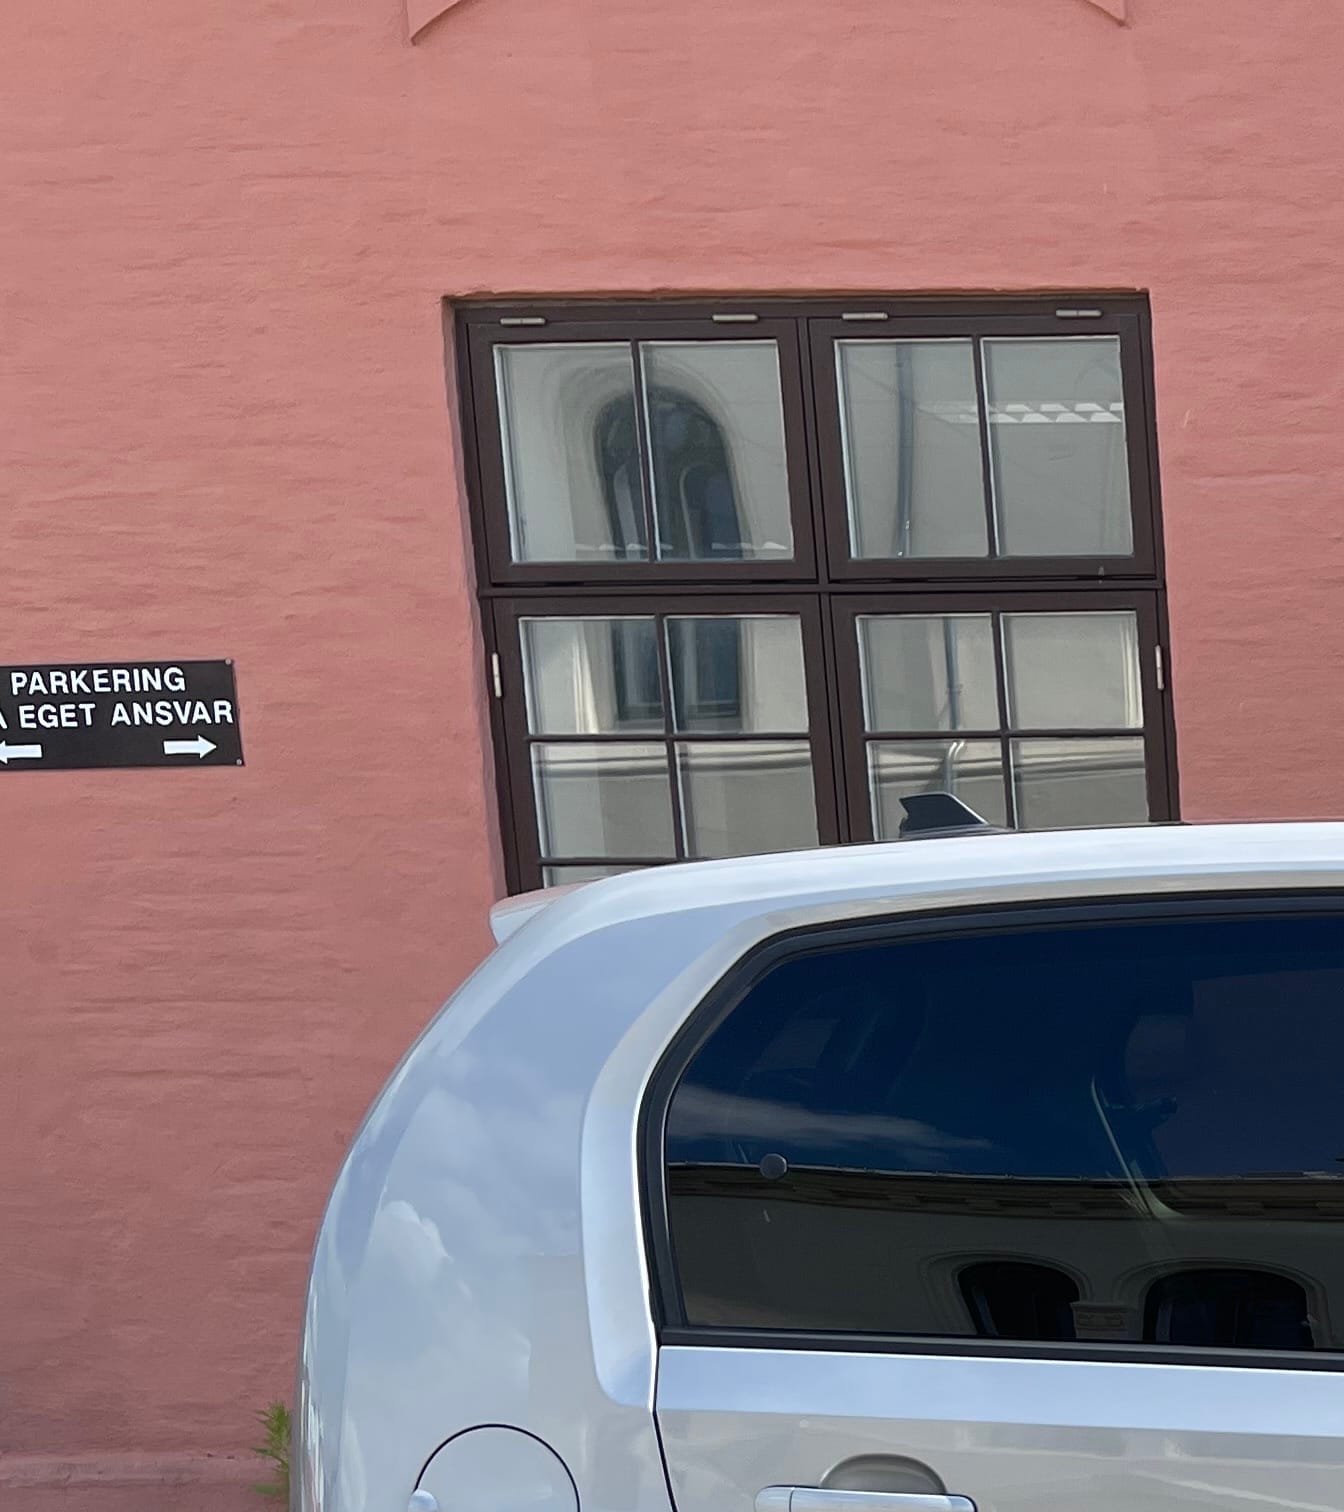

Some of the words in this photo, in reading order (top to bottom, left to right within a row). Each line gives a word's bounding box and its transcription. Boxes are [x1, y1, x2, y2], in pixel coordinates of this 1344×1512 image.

[12, 667, 185, 695] PARKERING
[19, 704, 95, 728] EGET
[112, 701, 233, 725] ANSVAR
